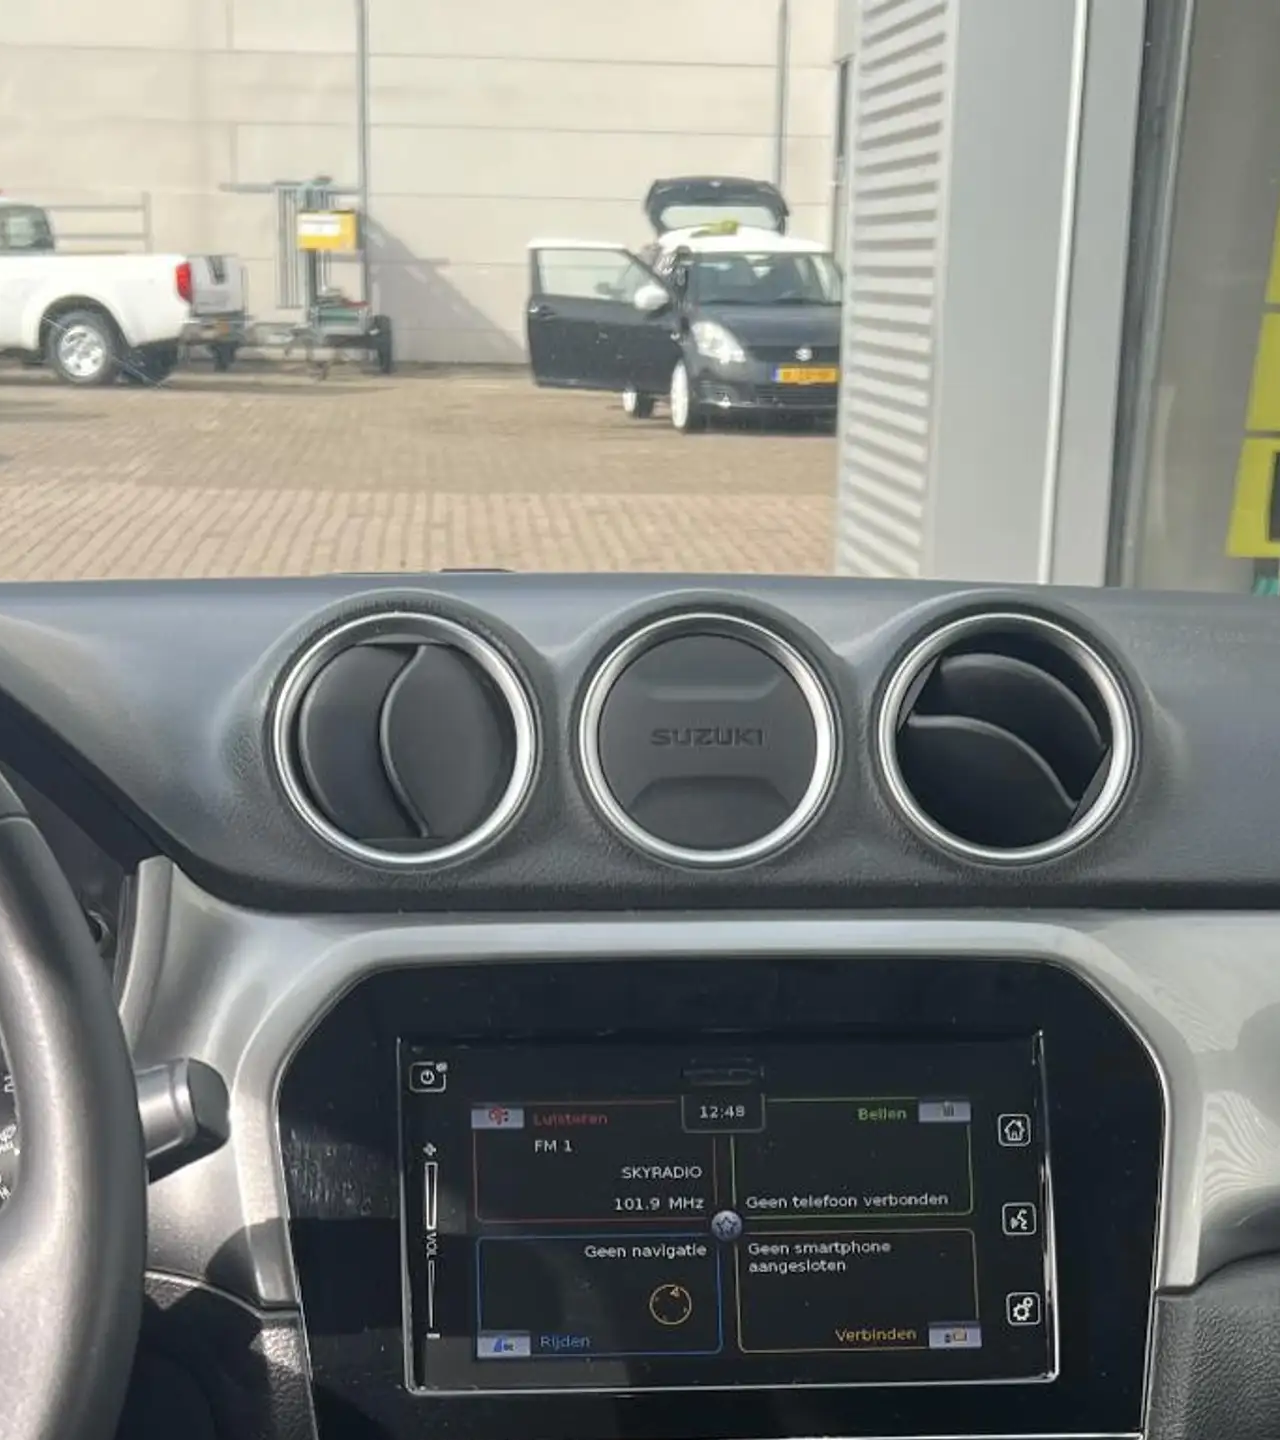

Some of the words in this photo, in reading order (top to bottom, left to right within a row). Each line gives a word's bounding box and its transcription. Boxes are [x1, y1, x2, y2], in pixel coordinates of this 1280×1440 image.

[650, 727, 767, 746] SUZUKI
[698, 1103, 745, 1119] 12:48
[857, 1108, 907, 1120] Bellen
[535, 1140, 557, 1152] FM
[564, 1140, 573, 1152] 1
[621, 1166, 703, 1179] SKYRADIO
[614, 1198, 660, 1211] 101.9
[669, 1197, 704, 1210] MHz
[745, 1197, 787, 1209] Geen
[793, 1195, 858, 1208] telefoon
[862, 1193, 949, 1207] verbonden
[426, 1232, 438, 1259] VOL
[584, 1245, 627, 1259] Geen
[632, 1243, 708, 1259] navigatie
[748, 1243, 789, 1255] Geen
[794, 1240, 891, 1256] smartphone
[749, 1260, 846, 1274] aangesloten
[540, 1335, 591, 1350] Rijden
[835, 1328, 917, 1342] Verbinden
